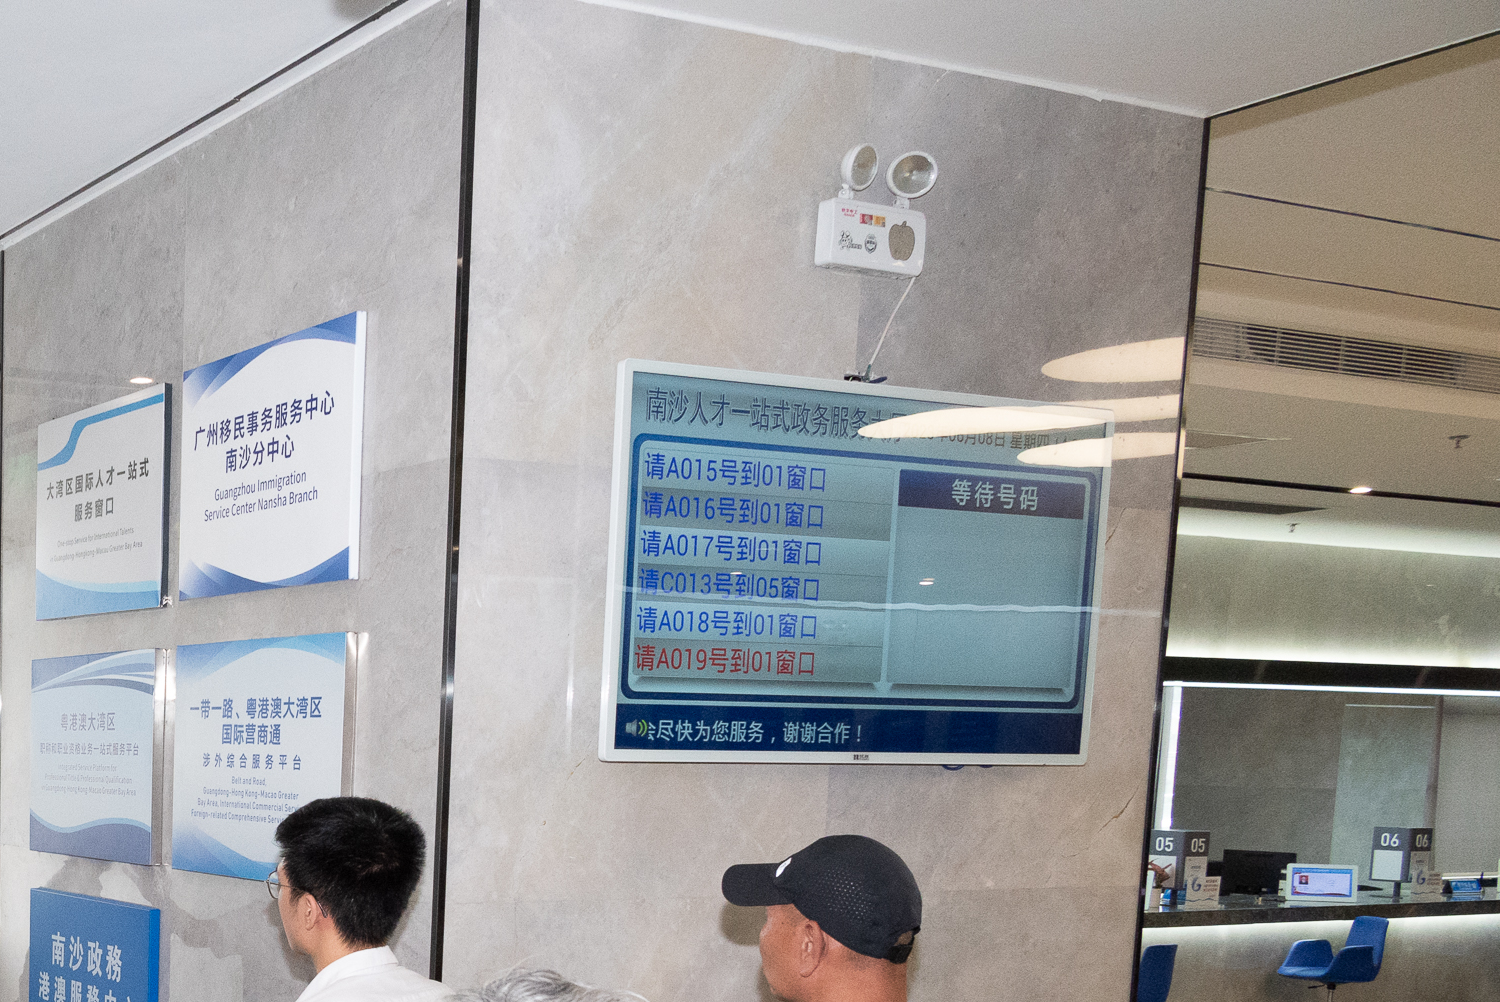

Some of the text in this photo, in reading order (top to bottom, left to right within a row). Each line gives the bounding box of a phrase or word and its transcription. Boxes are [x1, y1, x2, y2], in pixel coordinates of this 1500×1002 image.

[194, 390, 335, 451] 广州移民事务服务中心
[225, 434, 295, 473] 南沙分中心
[46, 457, 150, 501] 大湾区国际人才一站式
[645, 452, 826, 492] 请A015号到01窗口
[214, 470, 307, 501] Guangzhou Immigration
[951, 478, 1040, 512] 等待号码
[74, 497, 115, 522] 服务窗口
[204, 486, 318, 522] Service Center Nansha Branch
[643, 491, 824, 529] 请A016号到01窗口
[133, 540, 143, 549] Area
[641, 529, 822, 566] 请A017号到01窗口
[639, 568, 820, 602] 请C013号到05窗口
[637, 606, 817, 639] 请A018号到01窗口
[634, 644, 815, 676] 请A019号到01窗口
[190, 697, 322, 720] 一带一路、粤港澳大湾区
[60, 712, 116, 732] 粤港澳大湾区
[221, 724, 282, 745] 国际营商通
[40, 742, 139, 756] 职称和职业资格业务一站式服务平台
[203, 753, 302, 771] 涉外综合服务平台
[232, 776, 242, 785] Belt
[243, 778, 252, 786] and
[198, 798, 206, 808] Bay
[220, 800, 251, 811] International
[252, 802, 283, 812] Commercial
[278, 791, 299, 801] Greater
[191, 809, 227, 820] Foreign-related
[228, 812, 267, 822] Comprehensive
[1155, 837, 1174, 852] 05
[1191, 838, 1206, 853] 05
[1380, 833, 1400, 847] 06
[1415, 834, 1429, 848] 06
[52, 932, 122, 983] 南沙政務
